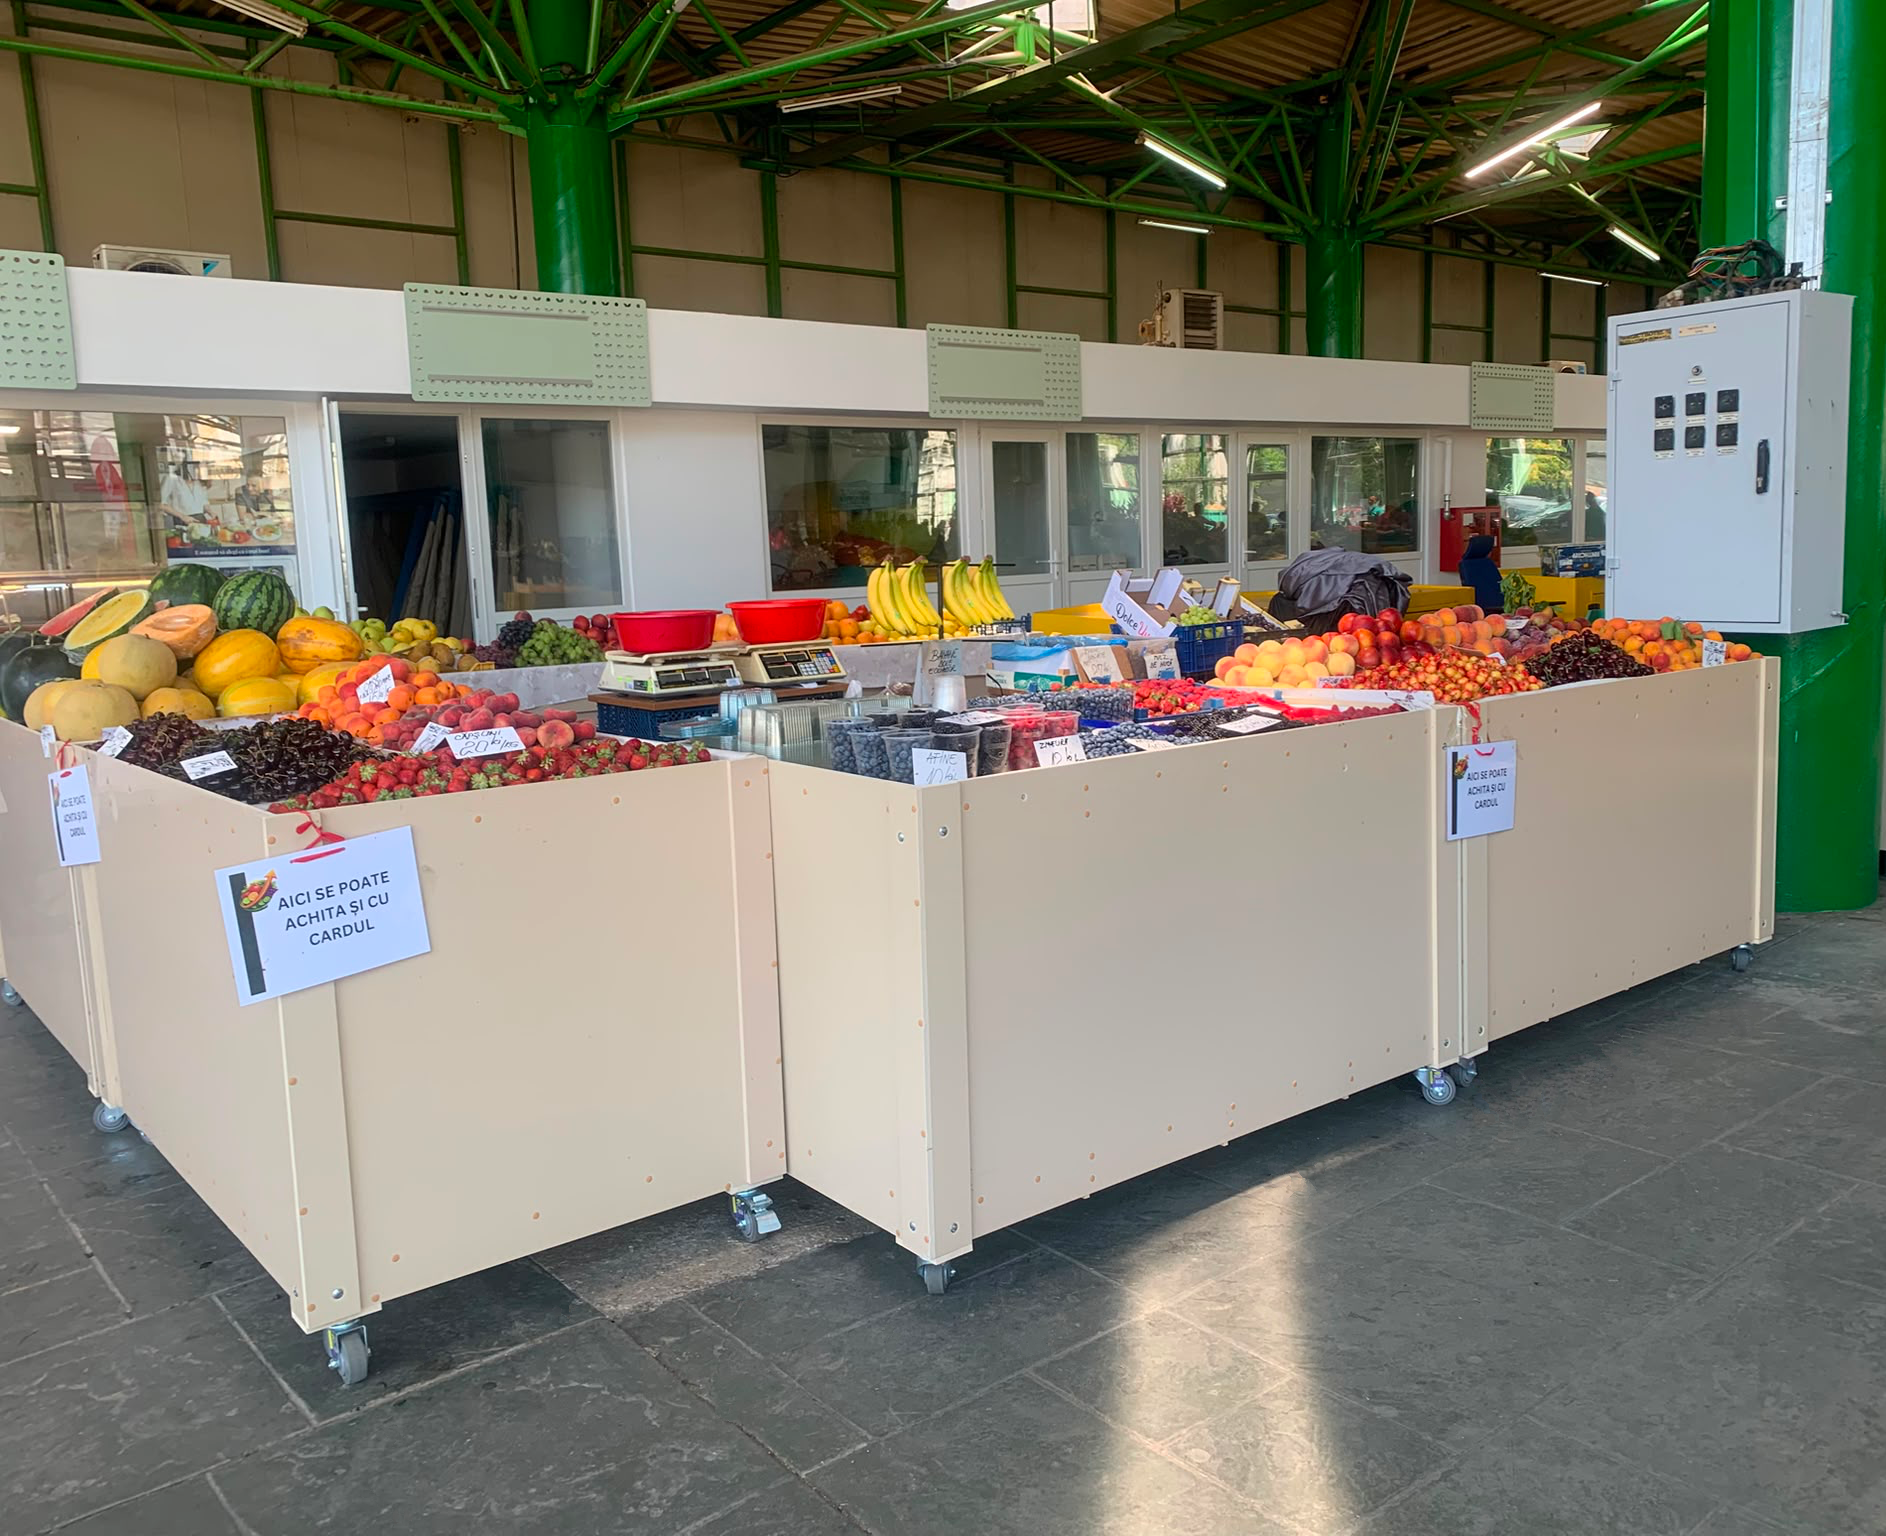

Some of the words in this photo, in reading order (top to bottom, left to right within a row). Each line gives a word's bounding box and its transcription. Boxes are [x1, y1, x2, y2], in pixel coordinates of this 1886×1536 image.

[1115, 602, 1139, 631] Dolce
[459, 740, 489, 757] 20
[926, 751, 958, 766] AFINE
[1466, 773, 1479, 781] AICI
[1480, 771, 1489, 780] SE
[1489, 768, 1507, 778] POATE
[1468, 785, 1490, 795] ACHITA
[1497, 783, 1505, 791] CU
[1474, 799, 1498, 809] CARDUL
[278, 891, 311, 911] AICI
[315, 884, 335, 901] SE
[339, 870, 390, 895] POATE
[285, 904, 347, 931] ACHITA
[350, 898, 364, 917] ȘI
[368, 892, 389, 908] CU
[309, 918, 375, 946] CARDUL
